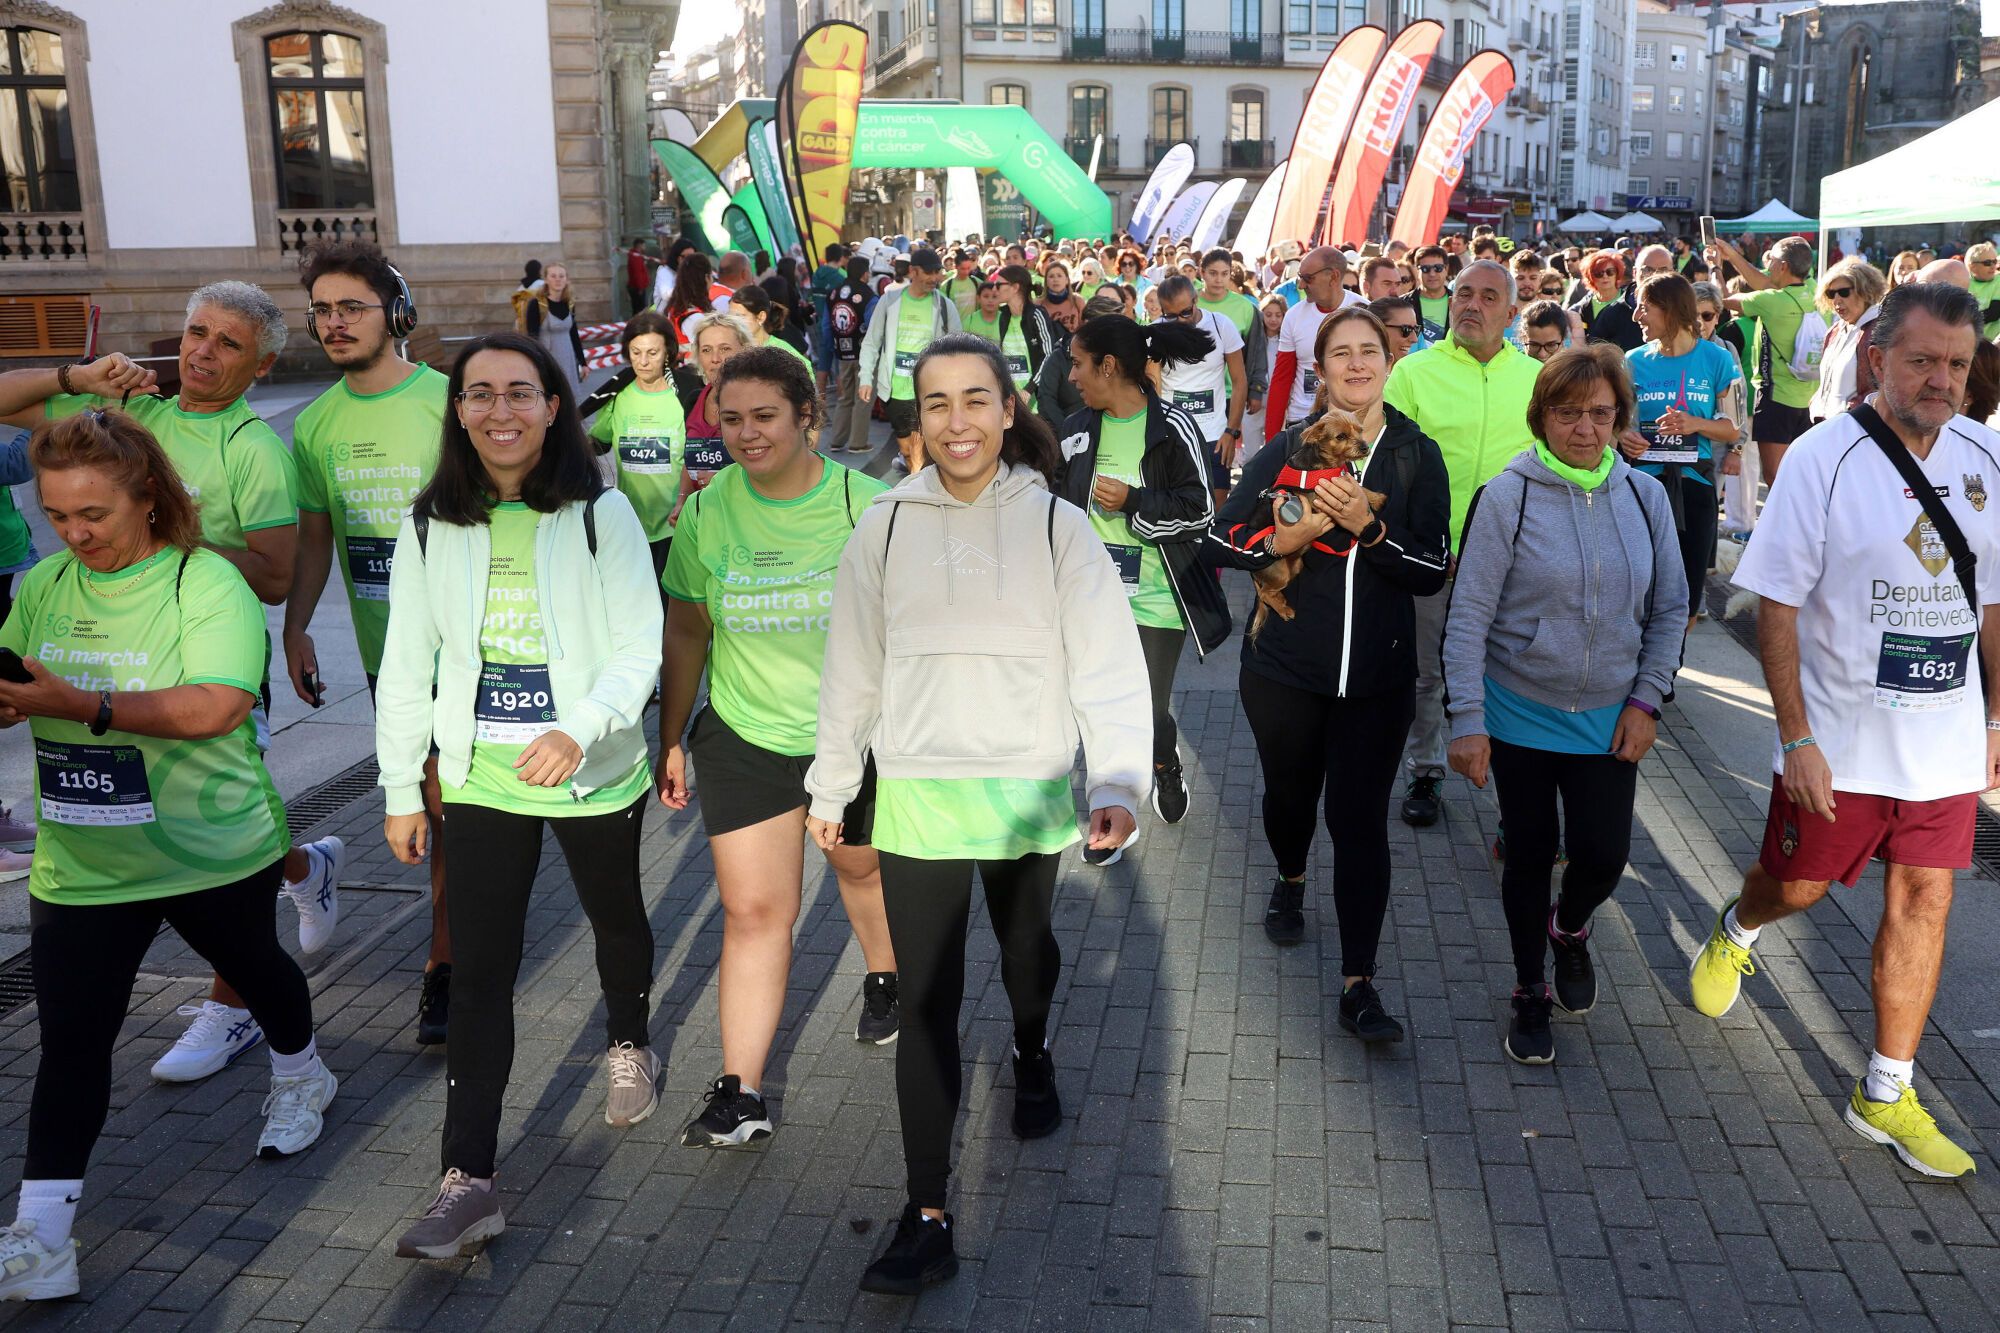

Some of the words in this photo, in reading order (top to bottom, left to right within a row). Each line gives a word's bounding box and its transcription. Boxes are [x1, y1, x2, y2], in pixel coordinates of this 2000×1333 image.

[1303, 63, 1352, 150] FROIZ
[1357, 55, 1412, 147] FROIZ
[860, 113, 878, 124] En
[881, 113, 934, 124] marcha
[862, 127, 907, 138] contra
[802, 134, 849, 151] GADIS
[861, 141, 874, 152] el
[877, 141, 926, 152] cáncer
[1182, 401, 1206, 410] 0582
[1655, 434, 1682, 445] 1745
[630, 449, 657, 459] 0474
[695, 450, 722, 464] 1656
[336, 466, 355, 481] En
[360, 463, 421, 480] marcha
[342, 484, 404, 503] contra
[725, 571, 751, 585] En
[756, 570, 832, 585] marcha
[723, 590, 810, 609] contra
[818, 591, 833, 606] o
[1872, 579, 1967, 607] Deputa
[487, 608, 543, 629] ntra
[724, 613, 831, 633] cancro
[1885, 635, 1931, 646] Pontevedra
[1896, 644, 1926, 653] marcha
[39, 642, 65, 662] En
[68, 648, 148, 666] marcha
[1908, 660, 1956, 681] 1633
[490, 691, 549, 711] 1920
[45, 751, 68, 760] marcha
[62, 760, 87, 769] cancro
[58, 769, 115, 793] 1165
